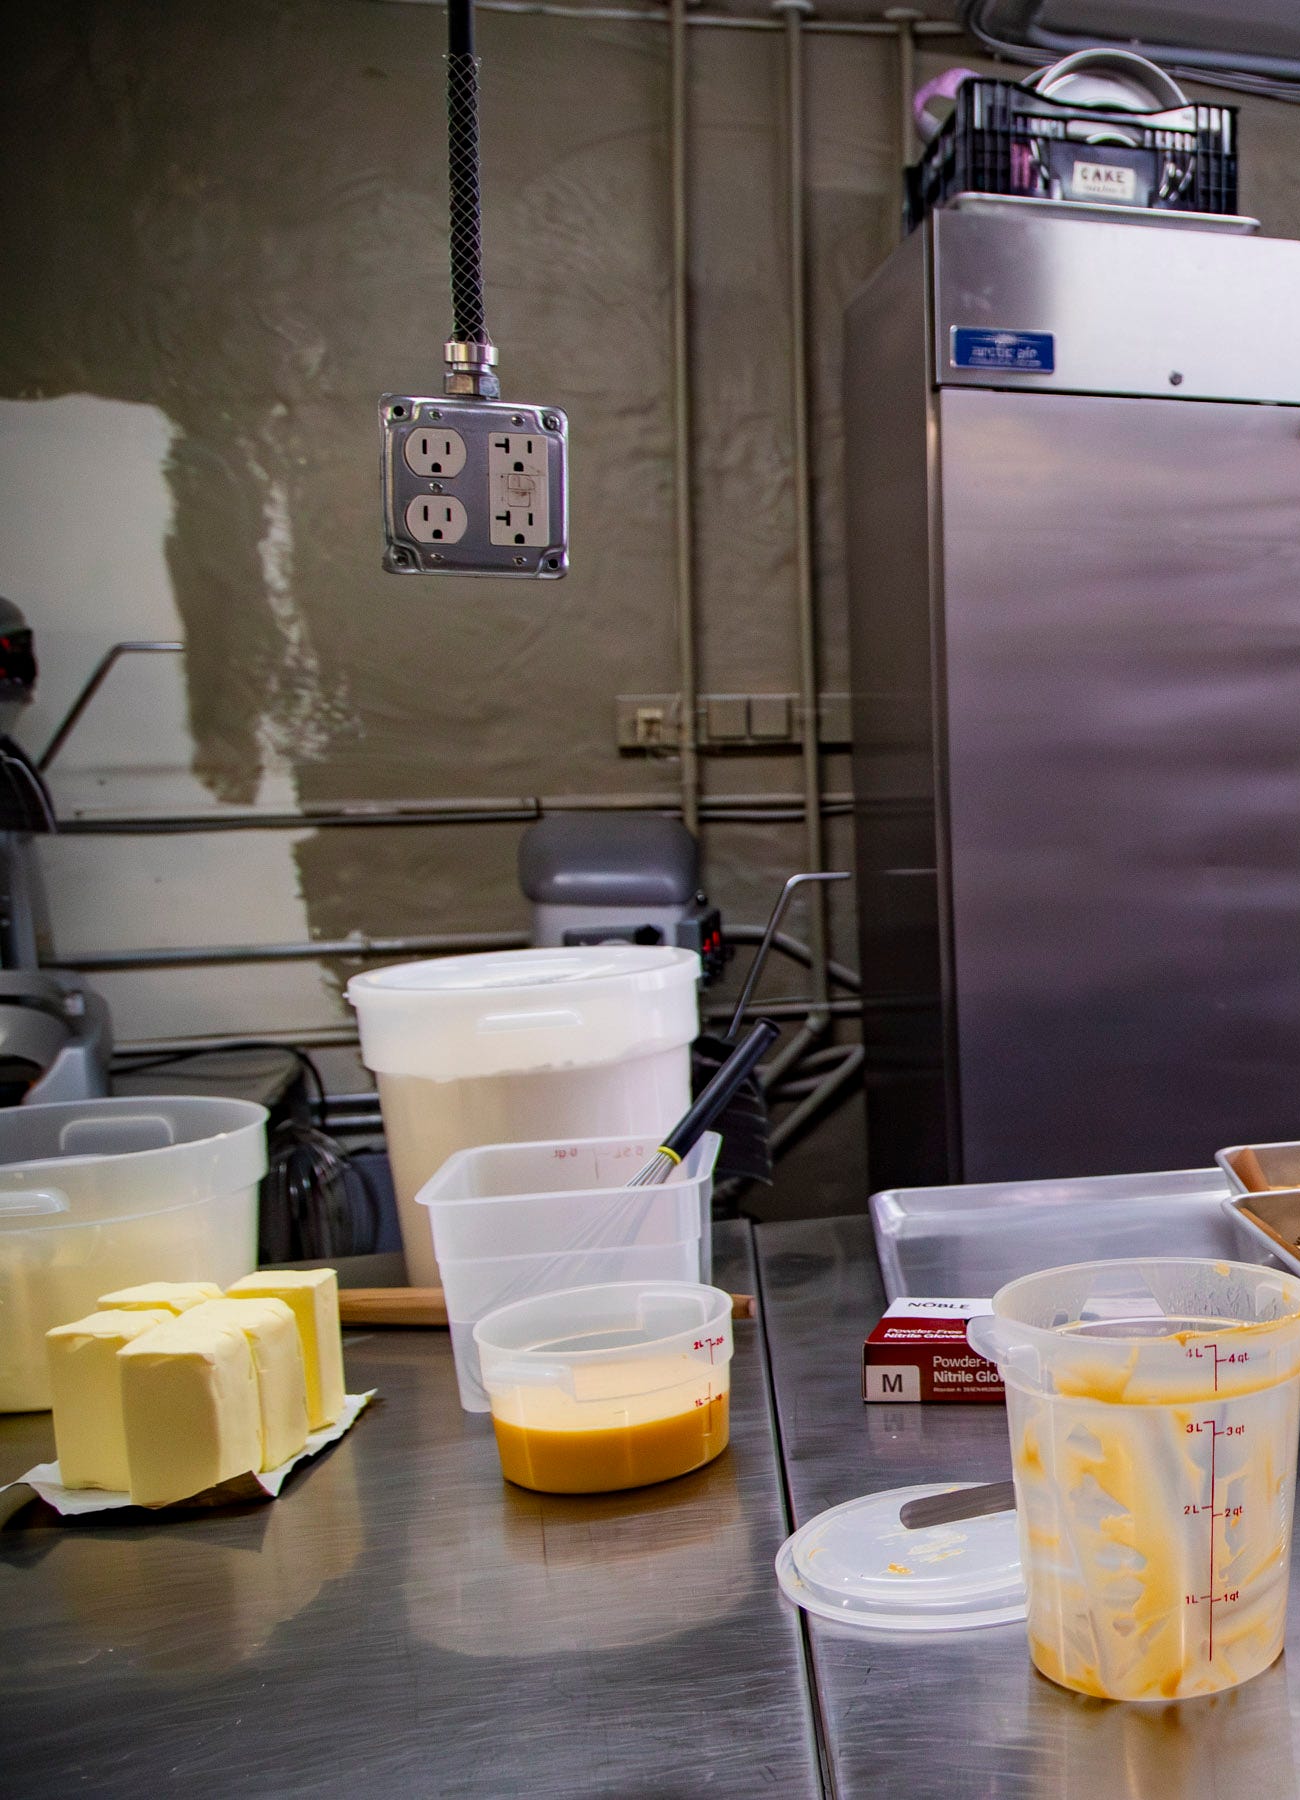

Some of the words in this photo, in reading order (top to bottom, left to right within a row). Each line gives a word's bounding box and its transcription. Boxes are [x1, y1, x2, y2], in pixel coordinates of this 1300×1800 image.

[1081, 167, 1125, 184] CAKE
[882, 1373, 903, 1393] M
[933, 1371, 973, 1383] Nitrile
[976, 1371, 1005, 1383] Glo
